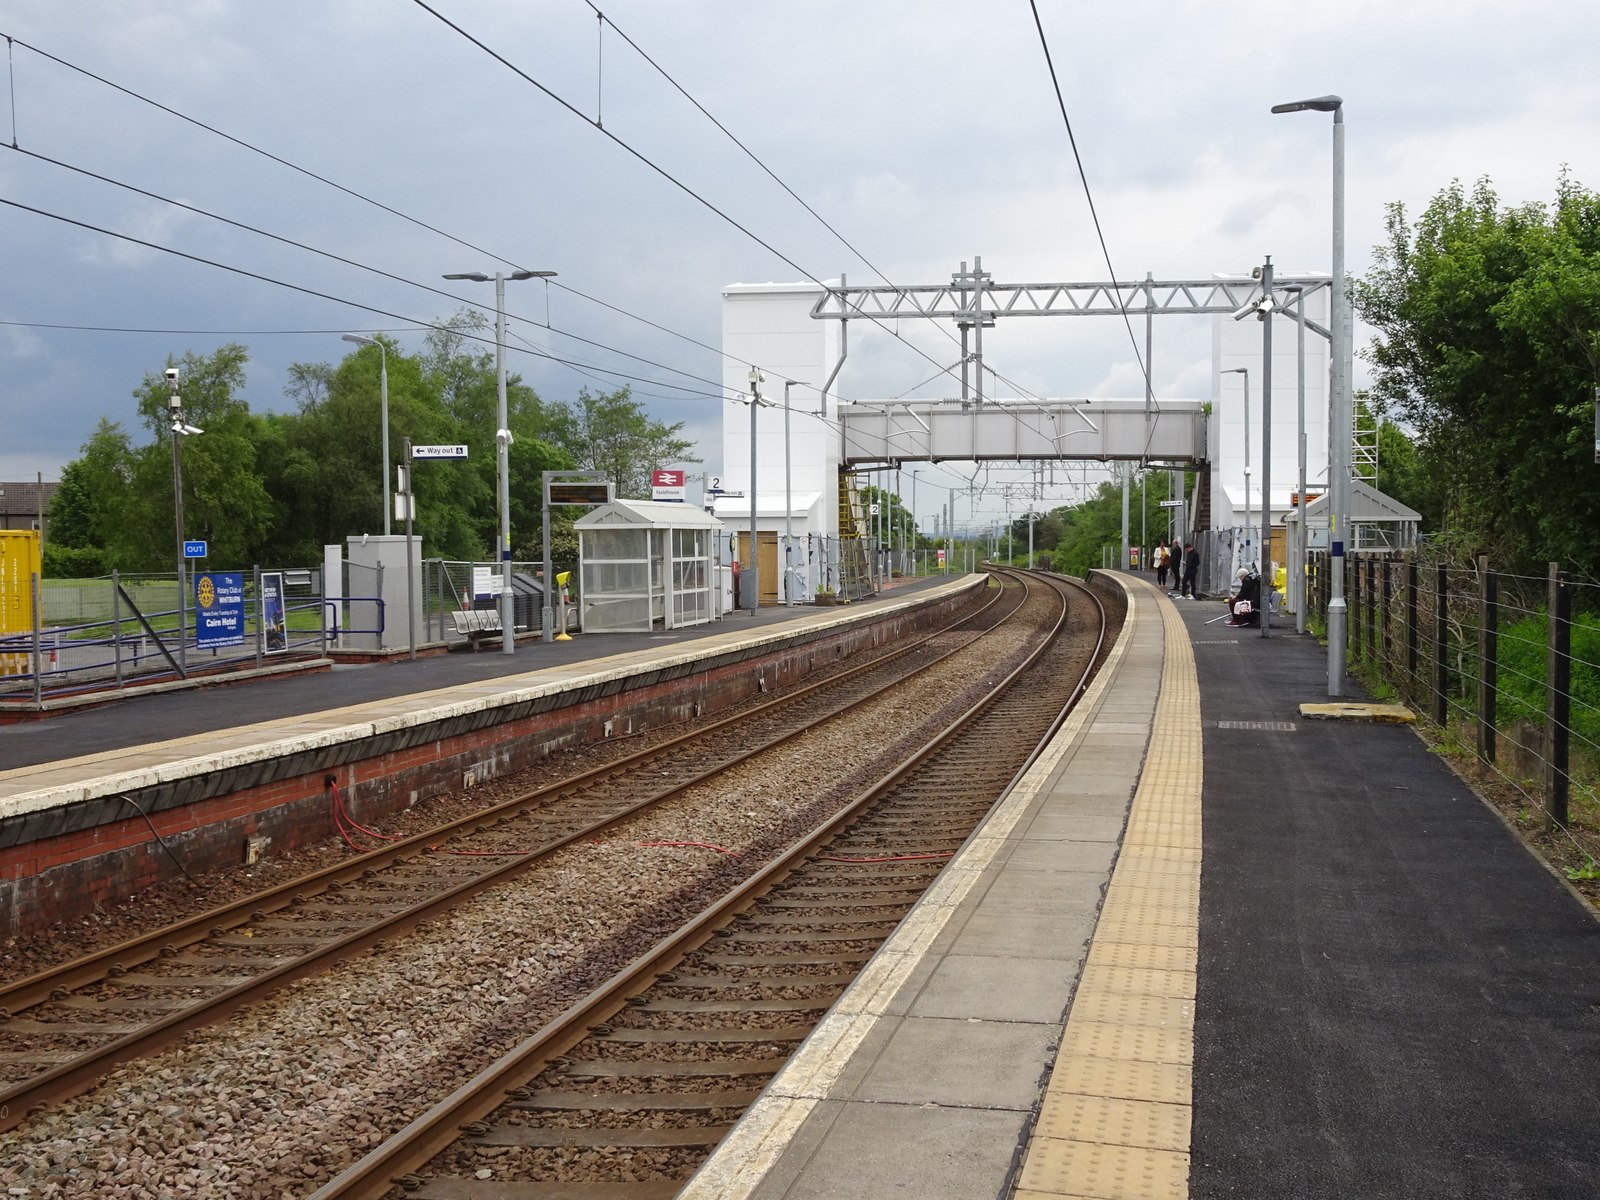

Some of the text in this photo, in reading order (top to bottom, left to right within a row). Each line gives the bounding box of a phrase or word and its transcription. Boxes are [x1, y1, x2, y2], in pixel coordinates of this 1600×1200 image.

[713, 478, 720, 488] 2
[206, 617, 237, 627] Cairn Hotel
